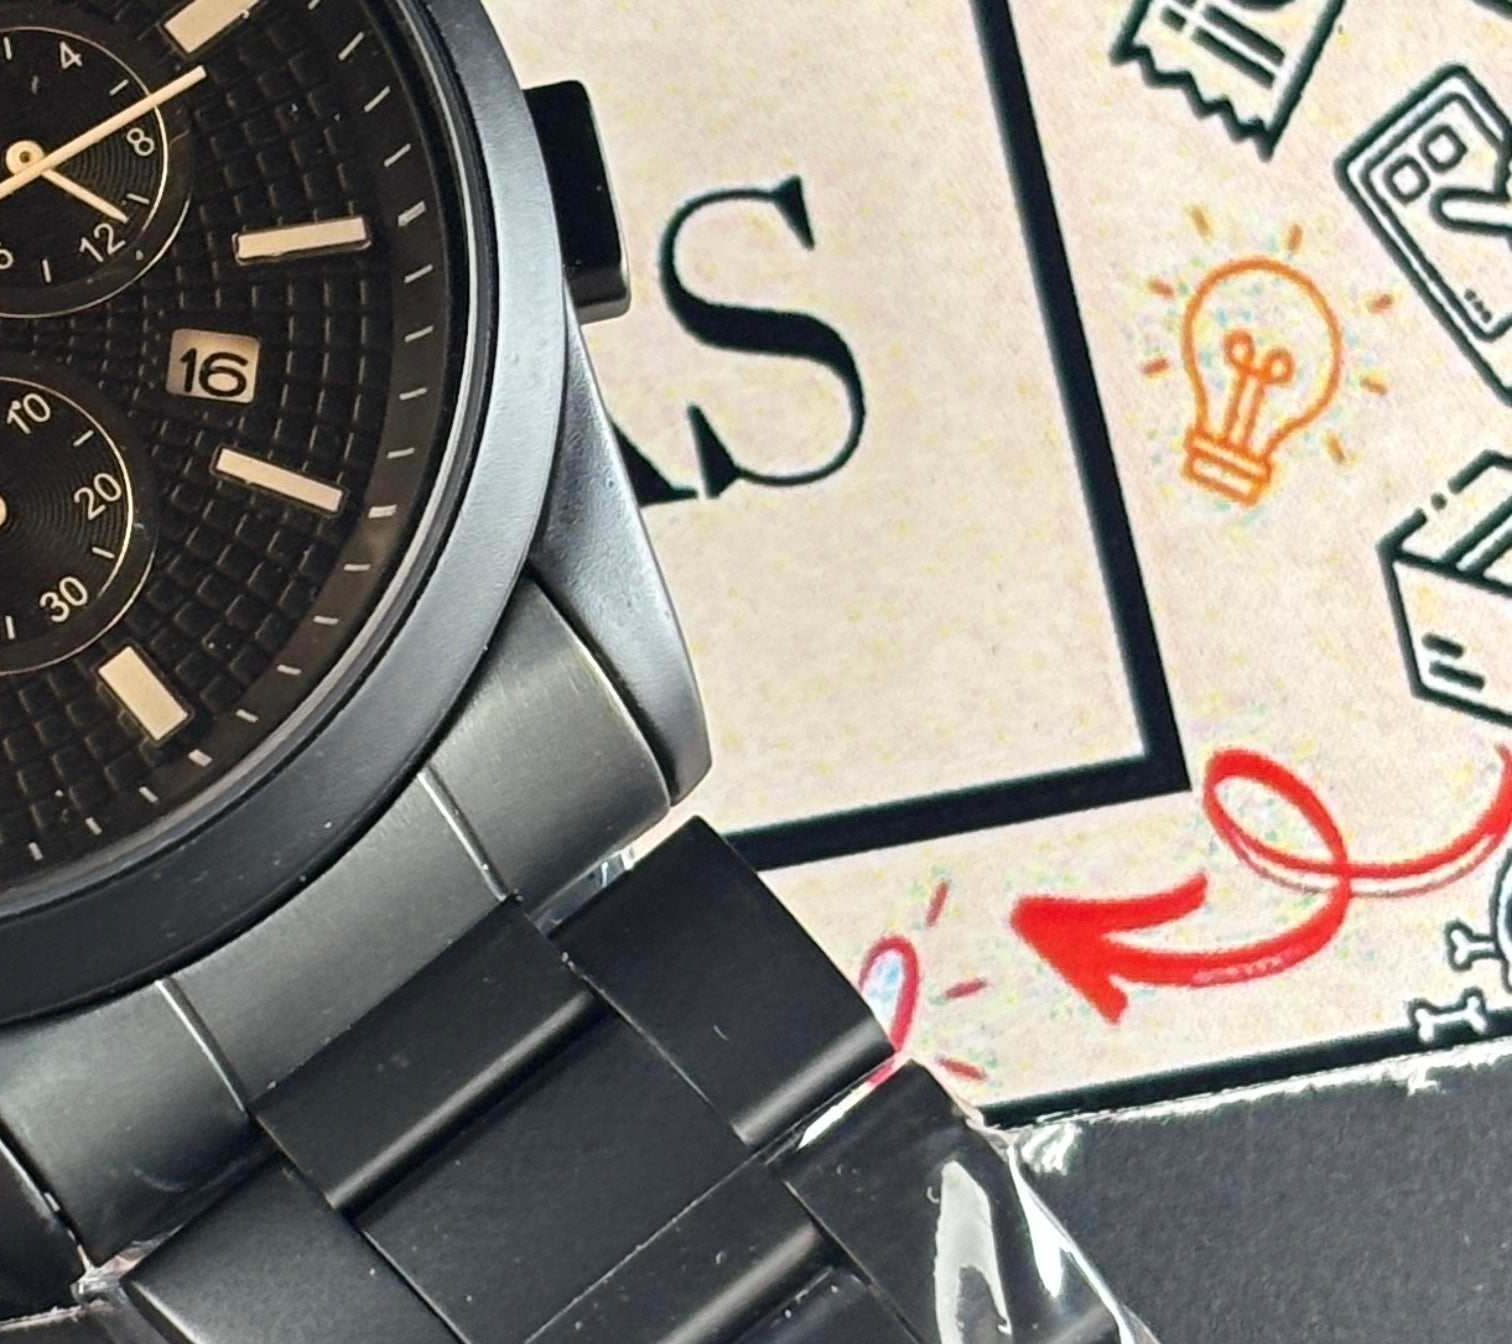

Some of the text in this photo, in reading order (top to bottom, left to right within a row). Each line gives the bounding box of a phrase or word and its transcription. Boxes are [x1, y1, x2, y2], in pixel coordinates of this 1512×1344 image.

[59, 41, 83, 70] 4
[126, 127, 155, 156] 8
[79, 222, 126, 262] 12
[179, 348, 248, 398] 16
[6, 393, 51, 434] 10
[73, 473, 122, 520] 20
[39, 576, 88, 623] 30
